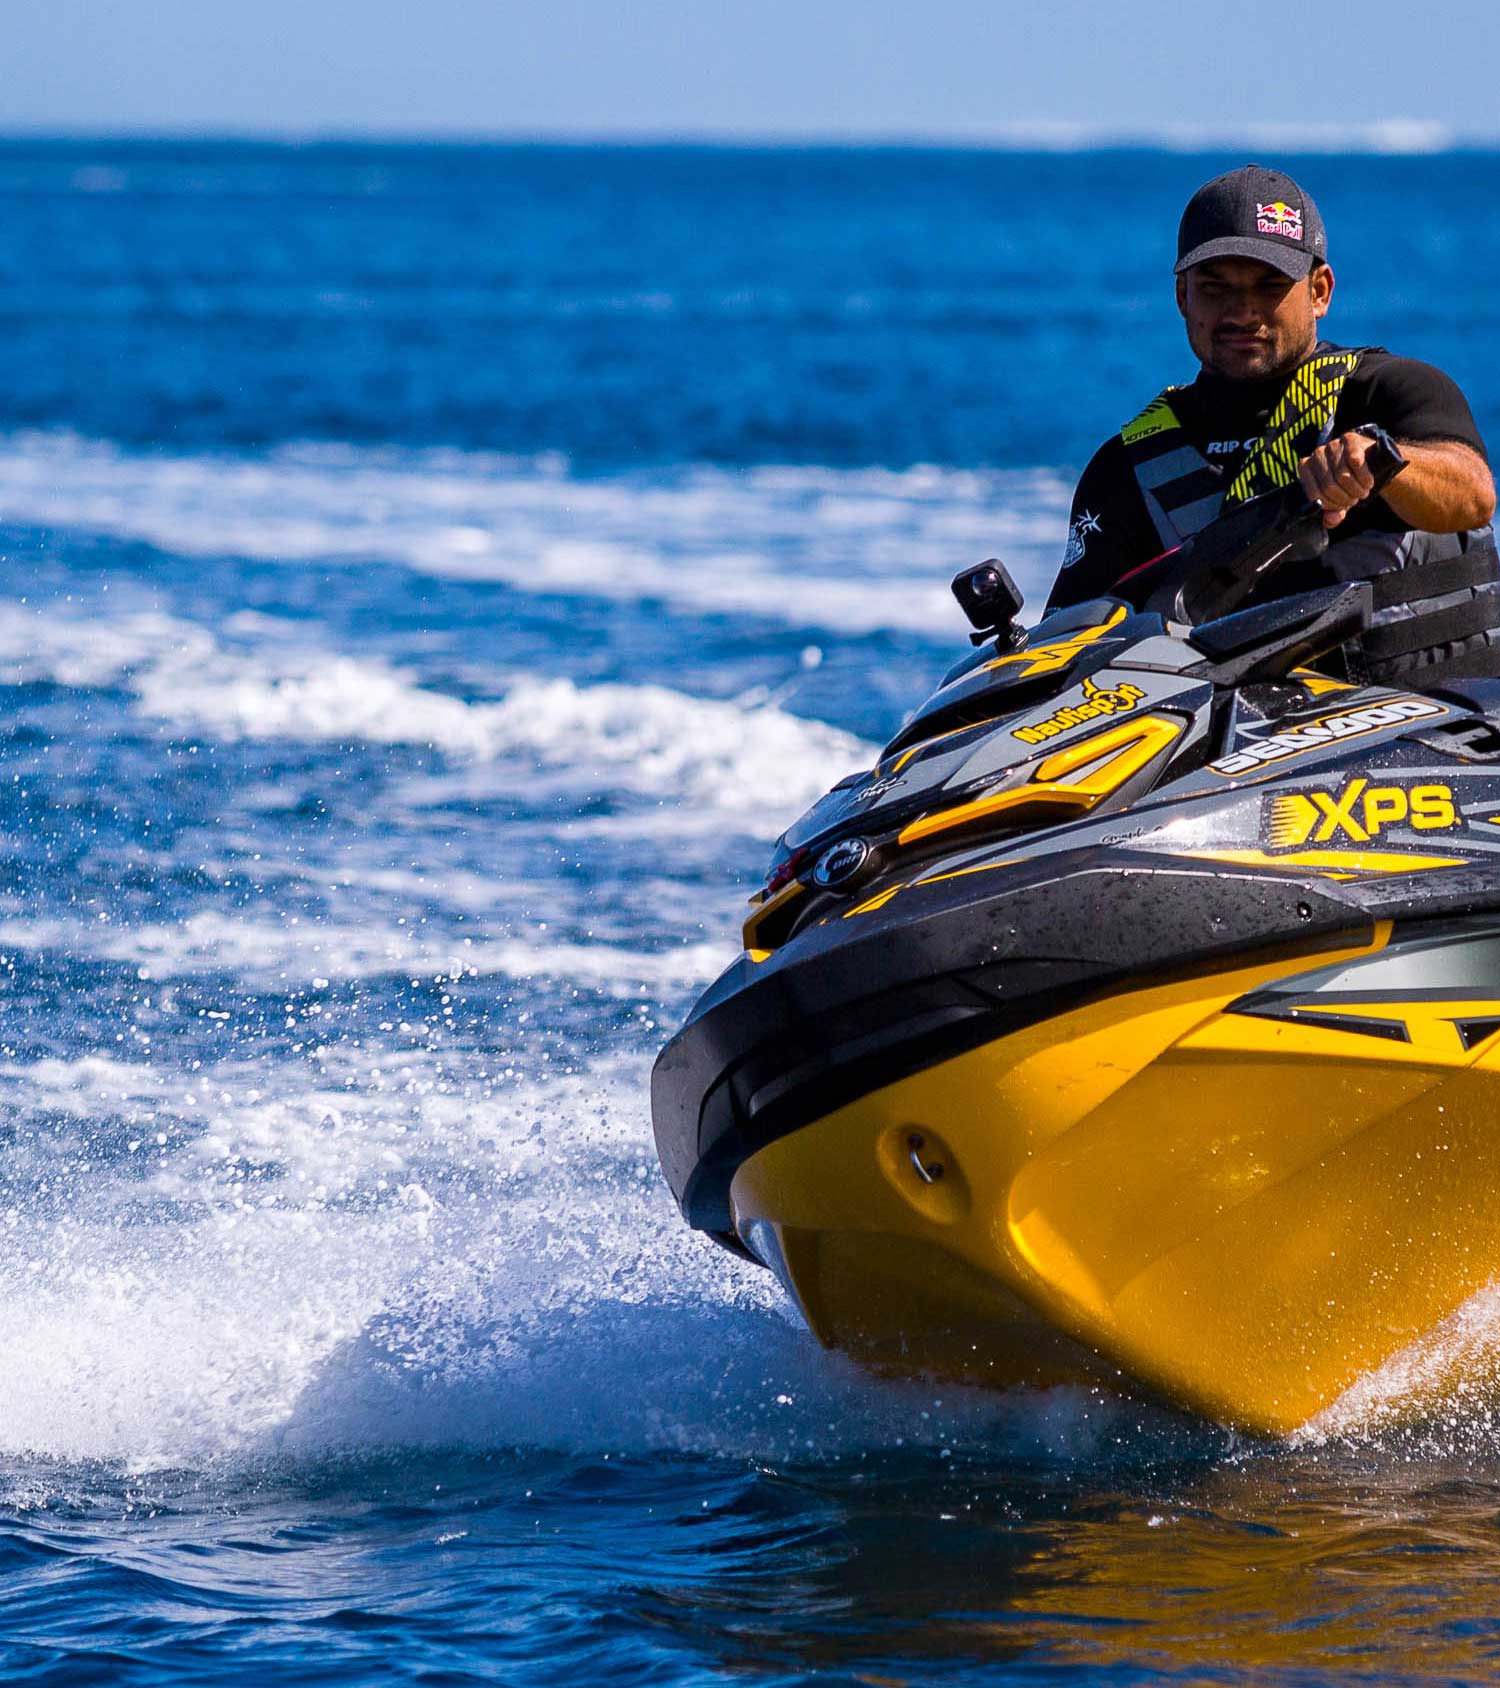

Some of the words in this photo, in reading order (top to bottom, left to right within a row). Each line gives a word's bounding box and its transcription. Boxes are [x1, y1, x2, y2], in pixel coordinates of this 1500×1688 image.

[1258, 219, 1282, 234] Red
[1282, 222, 1302, 240] Bull
[1207, 441, 1239, 454] RIP
[1311, 779, 1456, 842] XPS
